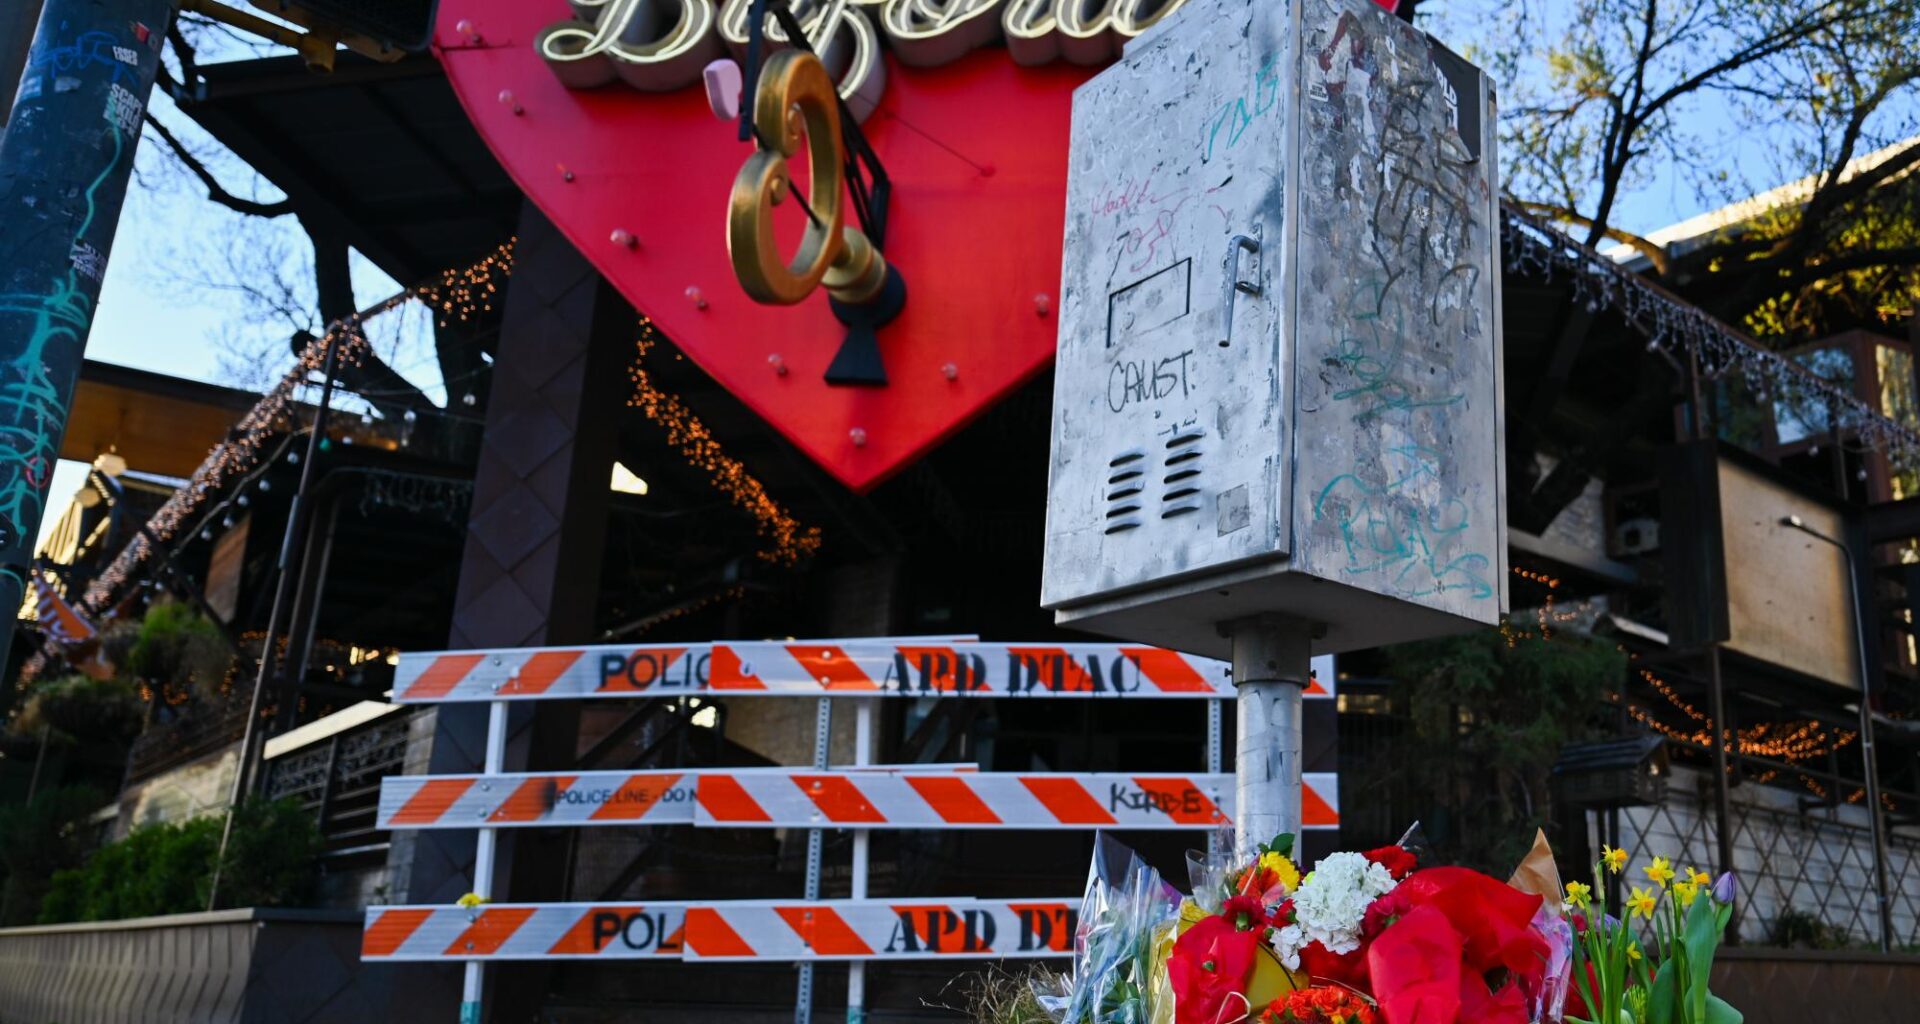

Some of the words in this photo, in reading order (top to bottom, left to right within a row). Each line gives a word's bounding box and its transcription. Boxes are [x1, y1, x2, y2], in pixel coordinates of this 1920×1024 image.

[879, 652, 987, 692] APD
[1005, 653, 1141, 693] DTAC
[557, 788, 612, 805] POLICE
[616, 788, 650, 804] LINE
[661, 787, 686, 803] DO
[592, 912, 679, 951] POL
[883, 908, 997, 953] APD
